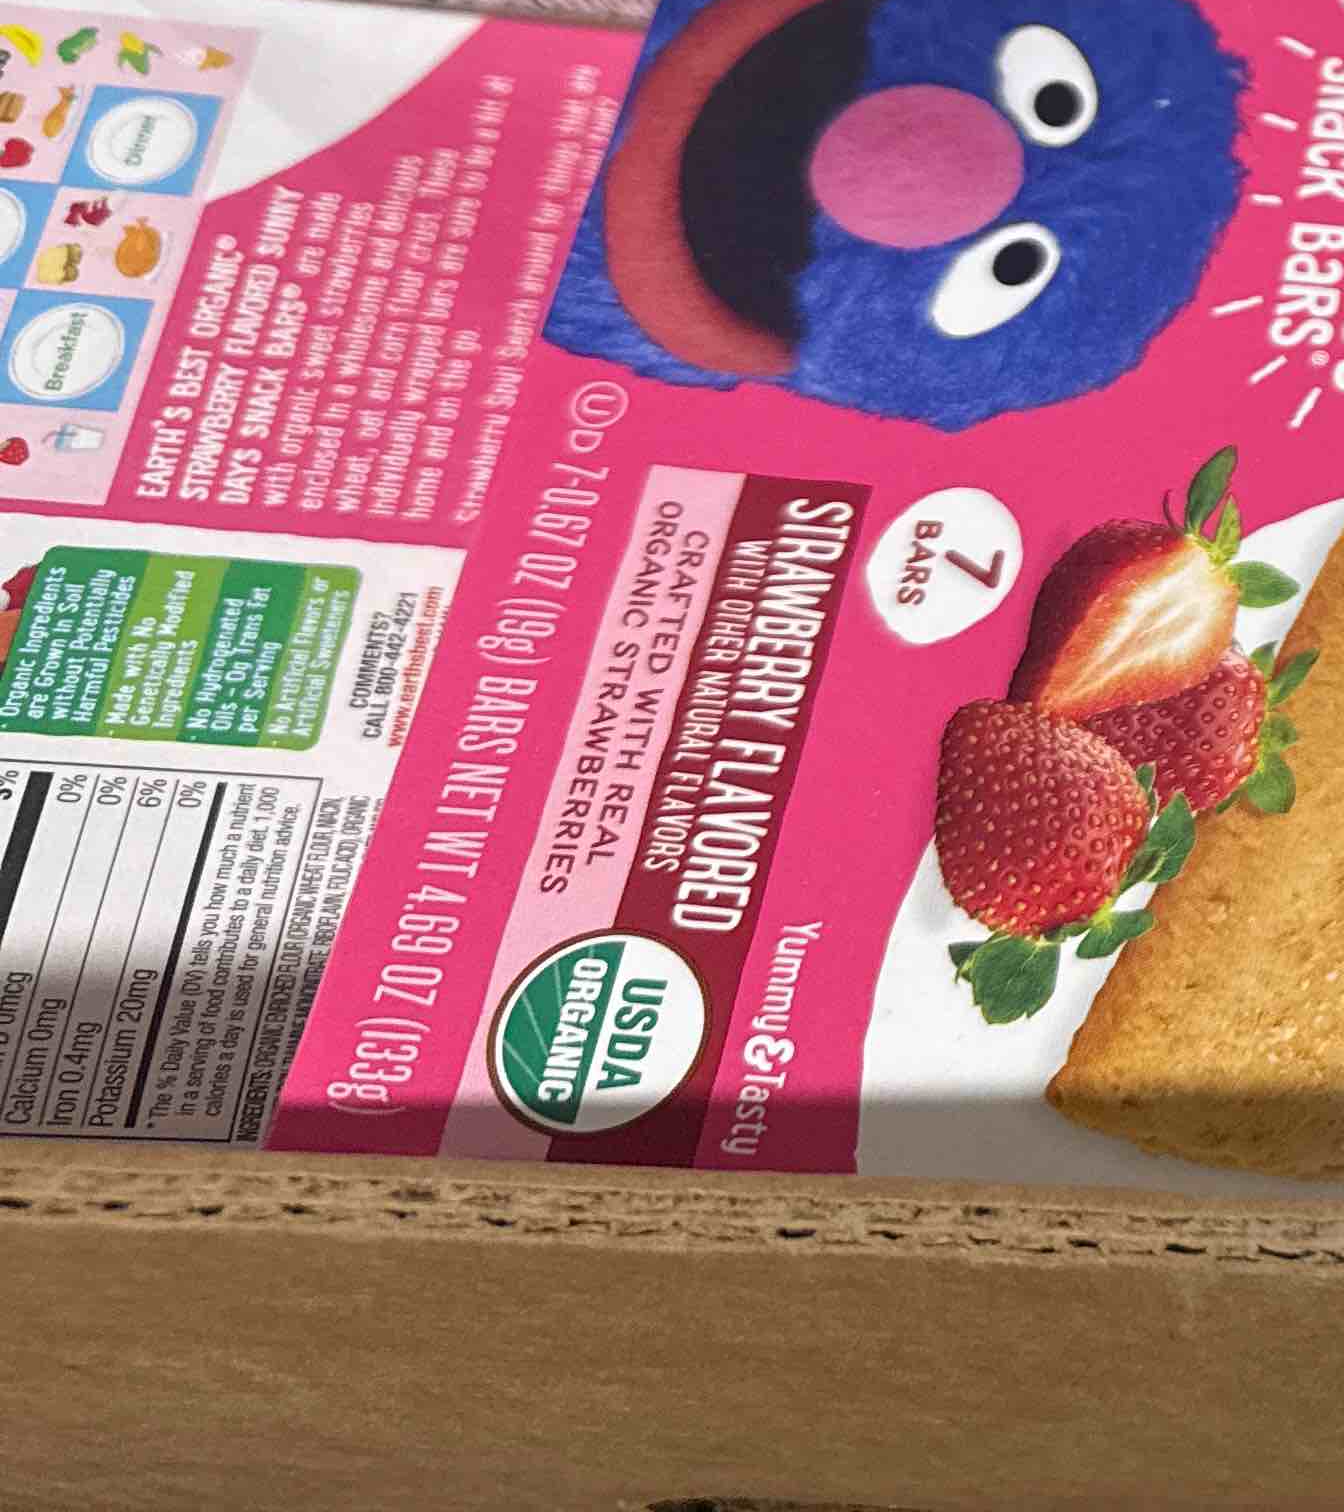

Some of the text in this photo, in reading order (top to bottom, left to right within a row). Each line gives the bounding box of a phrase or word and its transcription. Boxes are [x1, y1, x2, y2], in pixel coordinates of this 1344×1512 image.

[123, 114, 156, 167] Dinner
[44, 310, 87, 392] Breakfast
[897, 520, 944, 605] BARS
[944, 549, 1005, 589] 7
[350, 611, 391, 708] COMMENTS?
[539, 500, 685, 898] ORGANIC STRAWBERRIES
[585, 528, 710, 866] CRAFTED WITH REAL
[644, 539, 773, 874] WITH OTHER NATURAL FLAVORS
[671, 497, 855, 934] STRAWBERRY FLAVORED
[326, 465, 609, 1115] 7-0.67 OZ (19g) BARS NET WT 4.69 OZ (133g)
[536, 958, 608, 1103] ORGANIC
[595, 978, 670, 1091] USDA
